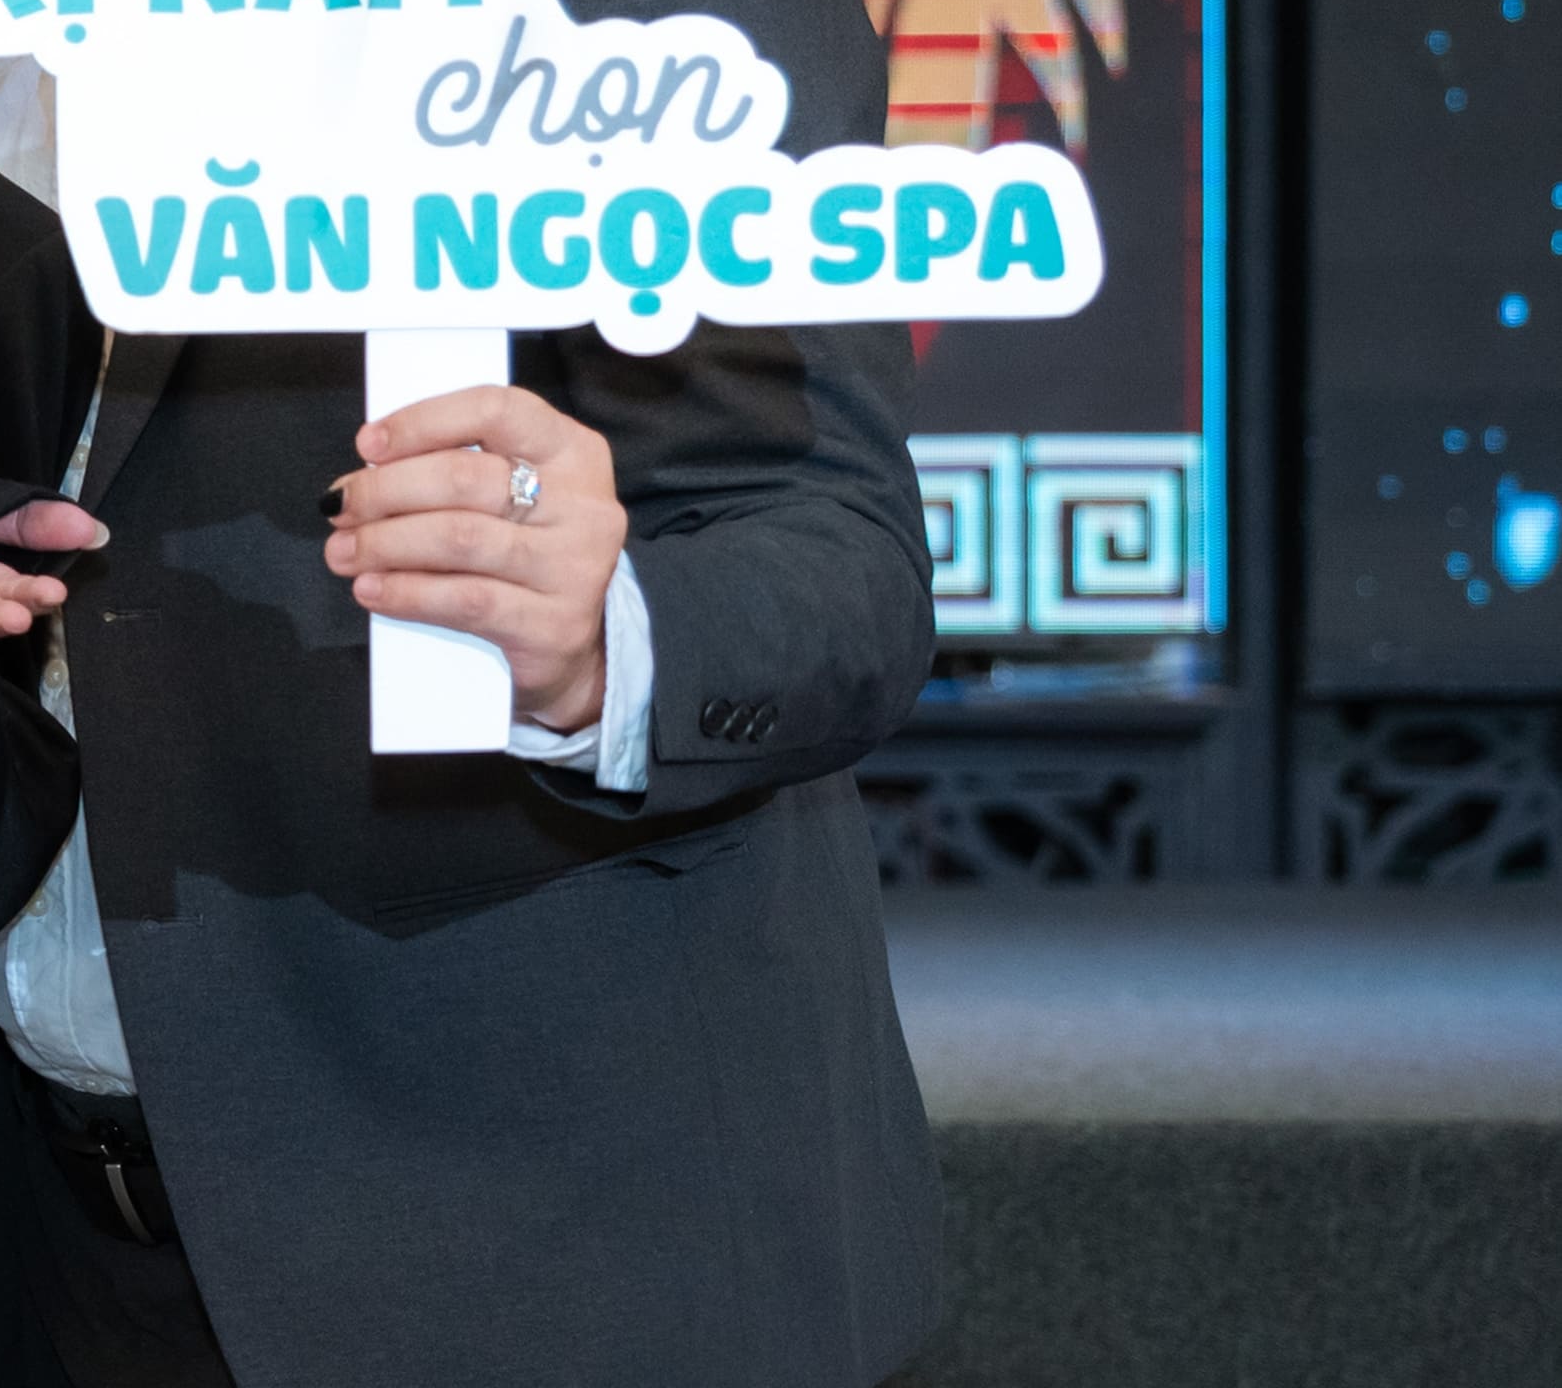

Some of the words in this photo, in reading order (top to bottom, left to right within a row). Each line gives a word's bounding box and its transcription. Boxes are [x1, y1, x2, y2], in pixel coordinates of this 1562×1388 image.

[415, 15, 754, 168] chọn
[95, 158, 371, 297] VĂN
[413, 185, 773, 317] NGỌC
[809, 180, 1067, 286] SPA
